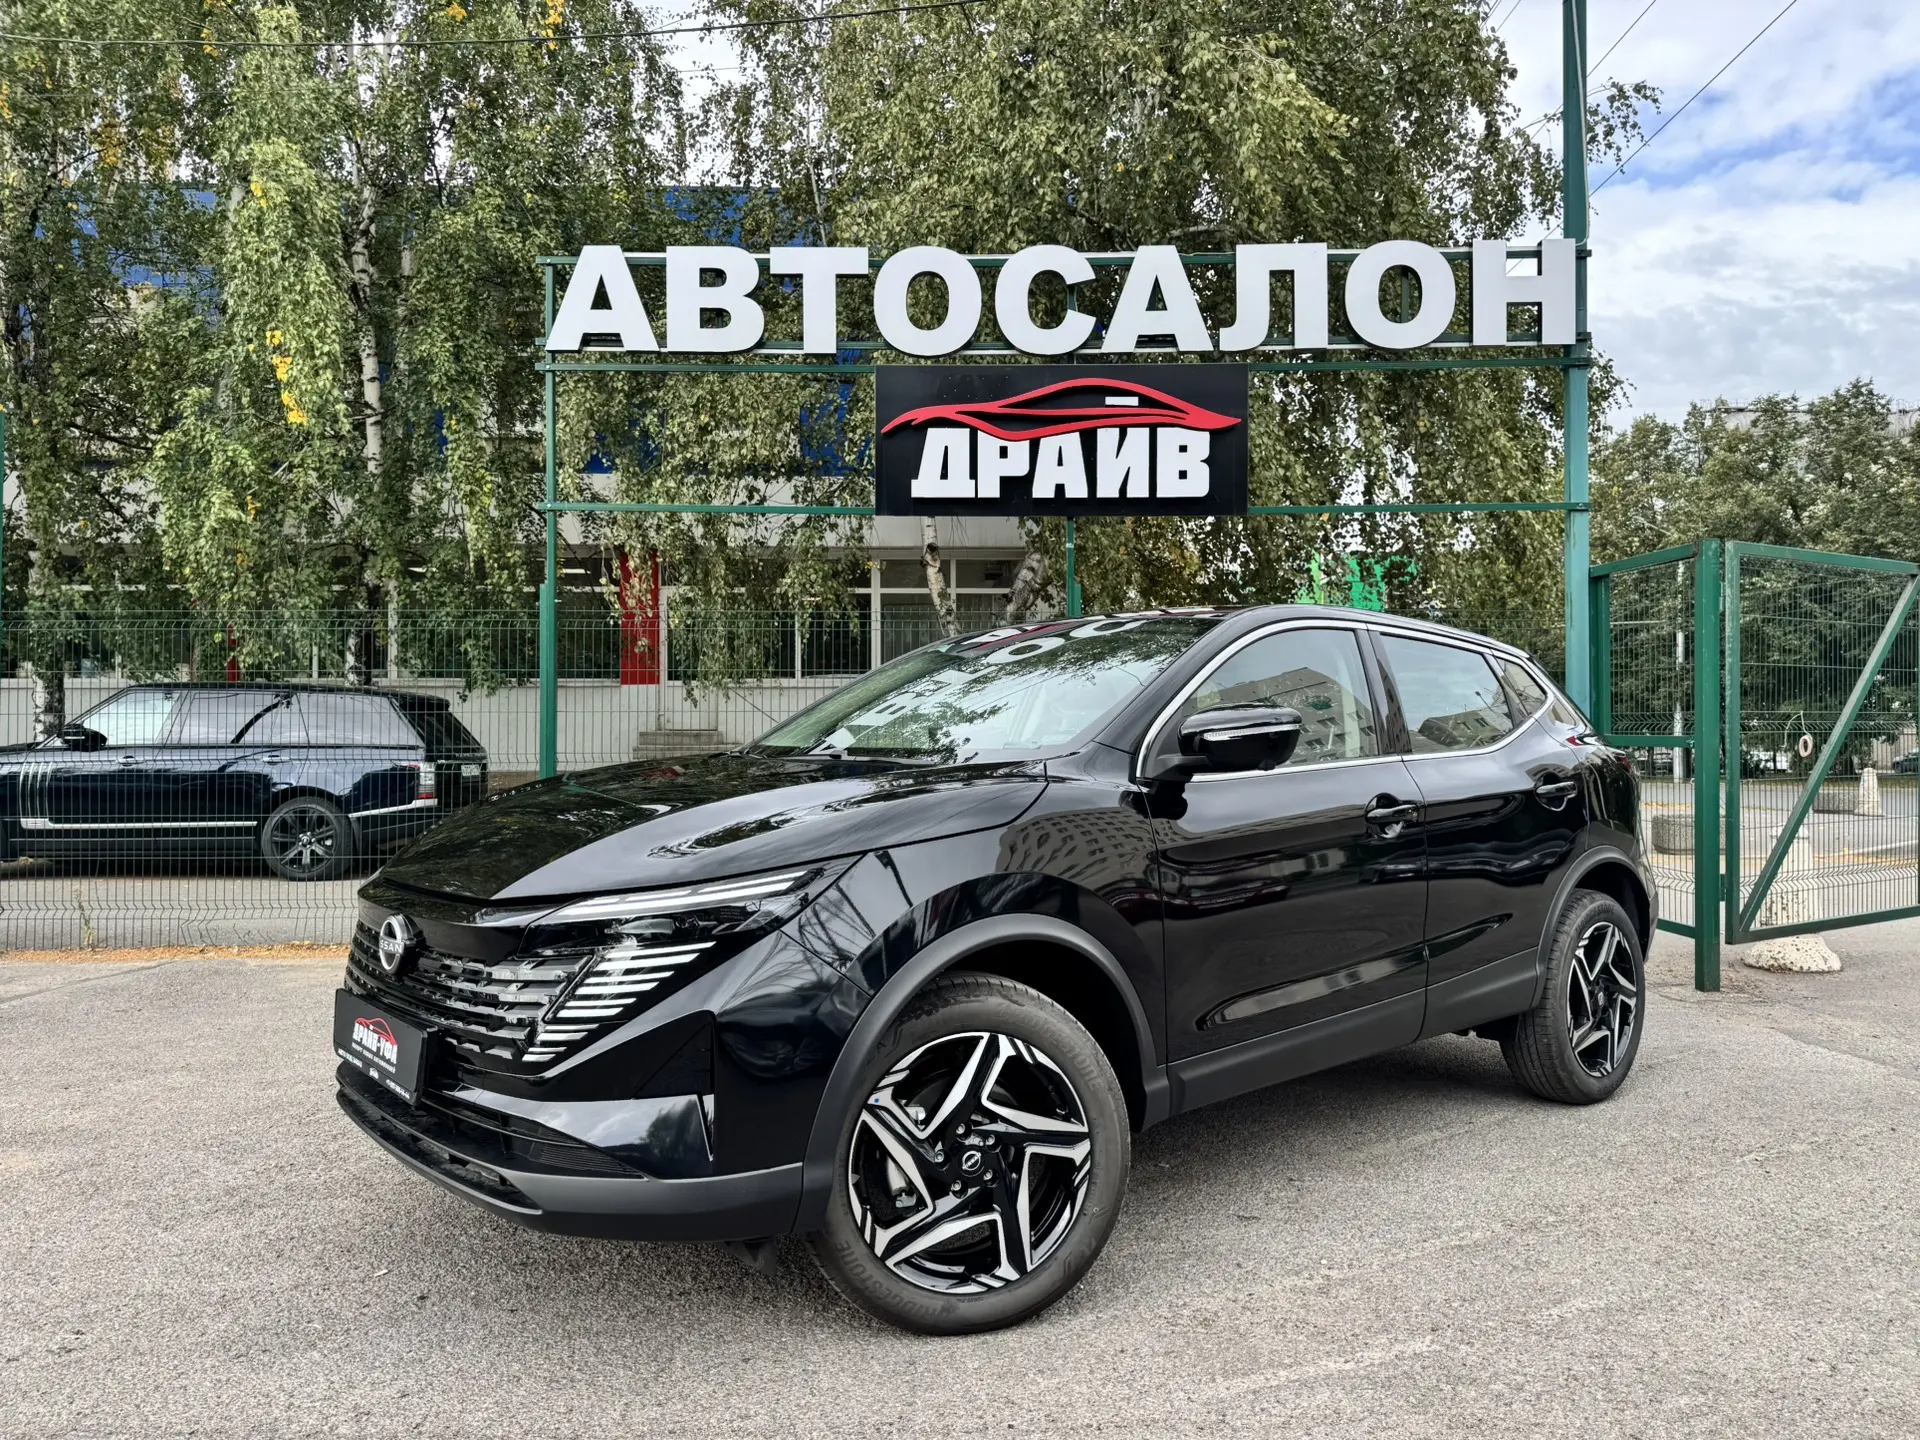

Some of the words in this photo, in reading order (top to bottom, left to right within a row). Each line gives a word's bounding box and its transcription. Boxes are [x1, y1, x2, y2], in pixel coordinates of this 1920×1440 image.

[545, 239, 1577, 356] АВТОСАЛОН
[911, 397, 1210, 498] ДРАЙВ
[379, 939, 402, 953] SSAN
